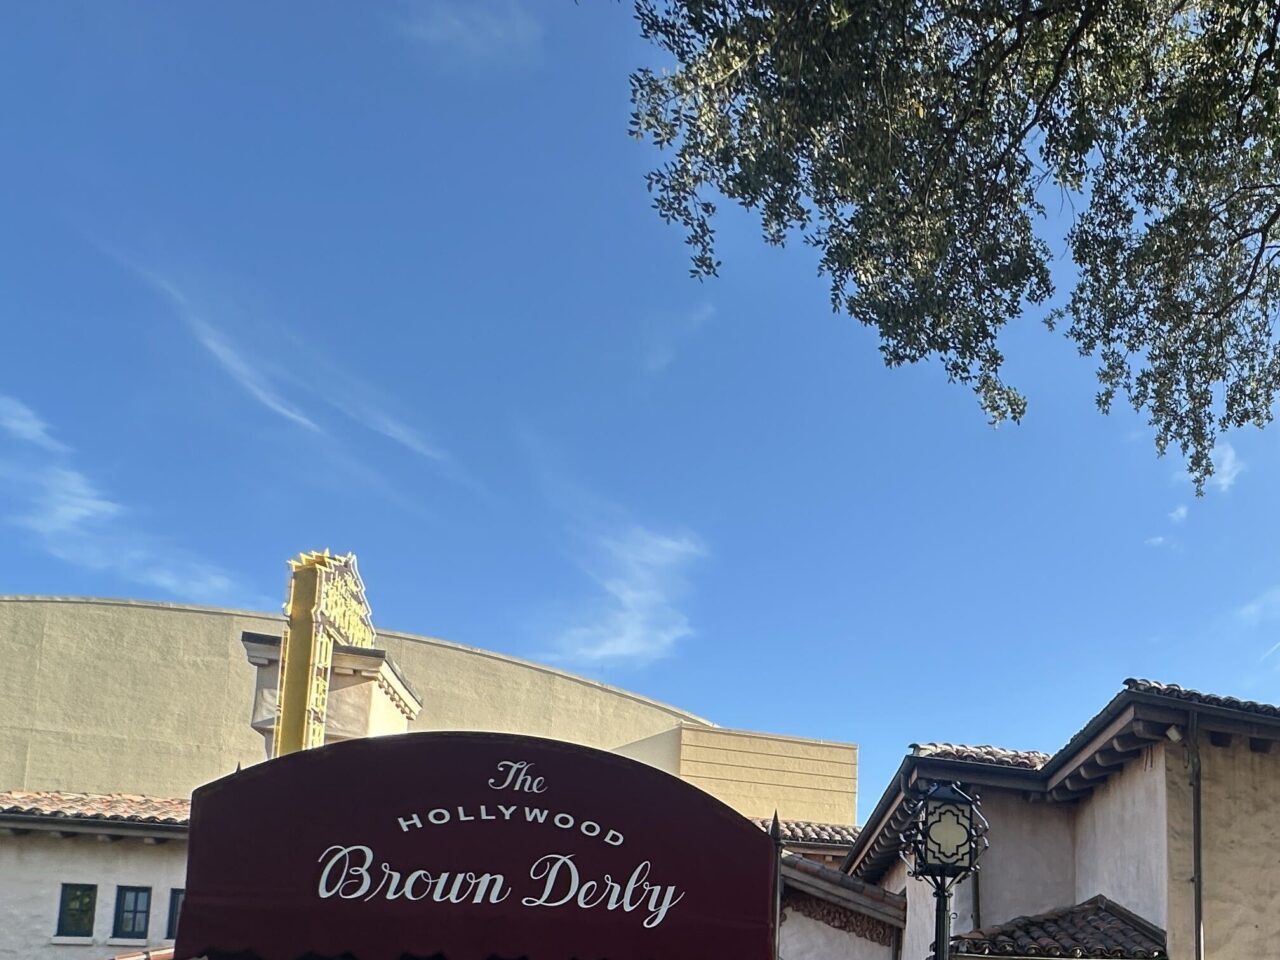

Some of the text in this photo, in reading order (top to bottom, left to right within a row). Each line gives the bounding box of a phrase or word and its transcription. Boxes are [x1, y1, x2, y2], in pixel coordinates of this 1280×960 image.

[488, 760, 547, 794] The
[397, 805, 625, 847] HOLLYWOOD
[317, 844, 685, 929] Brown Derby
